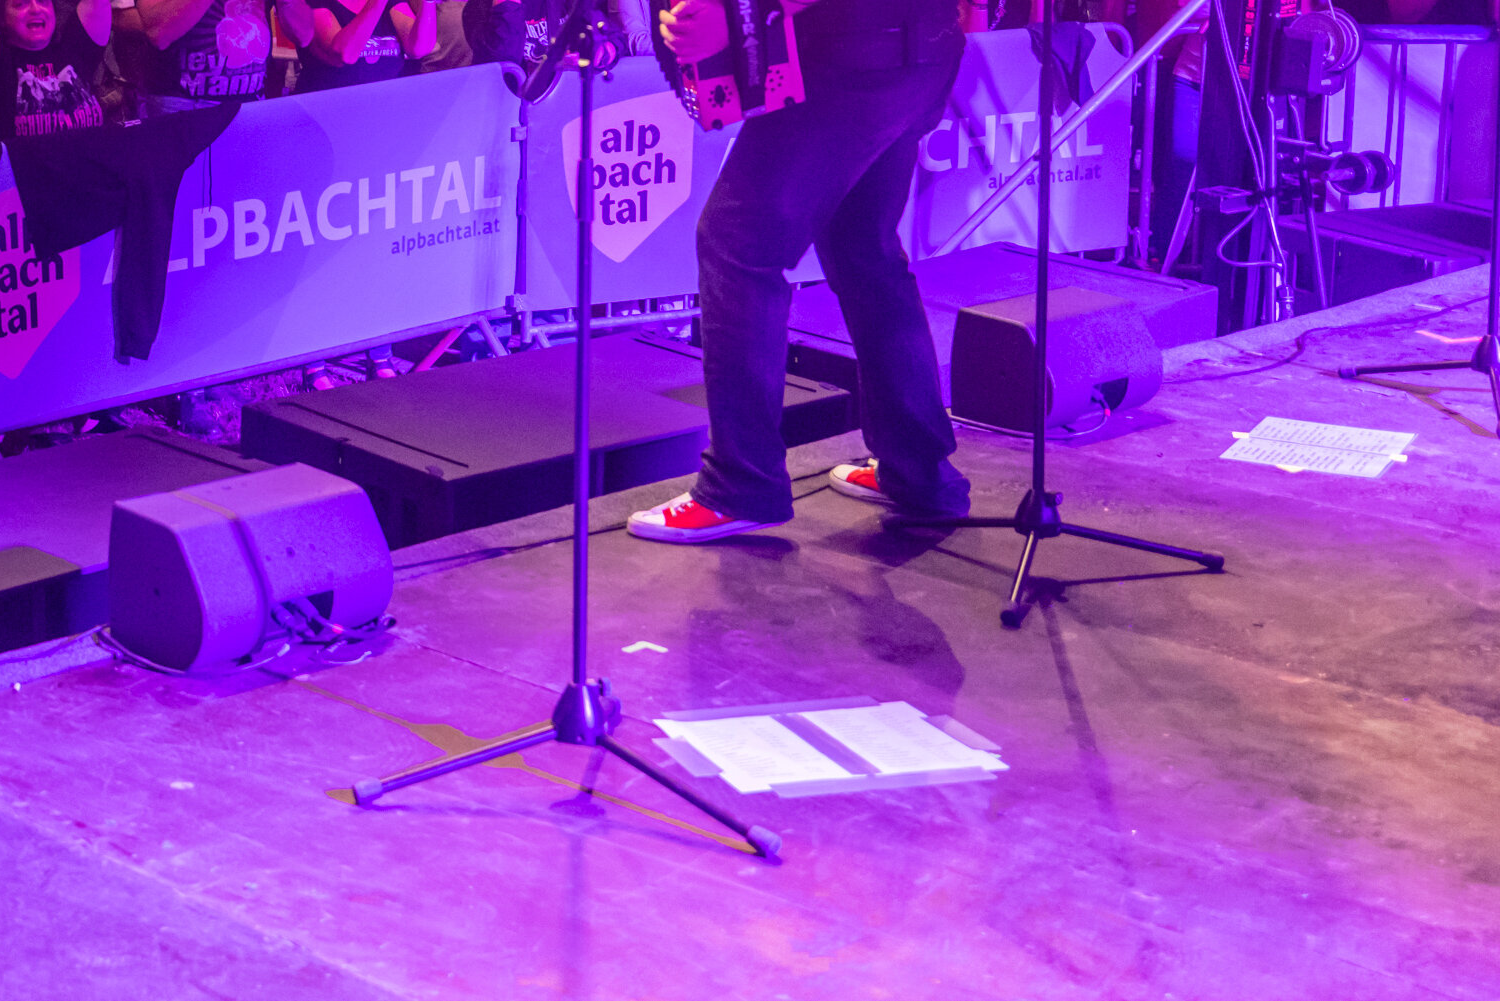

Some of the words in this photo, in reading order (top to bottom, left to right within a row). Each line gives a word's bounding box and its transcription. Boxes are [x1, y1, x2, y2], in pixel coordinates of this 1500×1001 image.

[600, 120, 660, 156] alp
[102, 155, 501, 286] PBACHTAL
[599, 190, 648, 226] tal
[390, 217, 501, 257] alpbachtal.at
